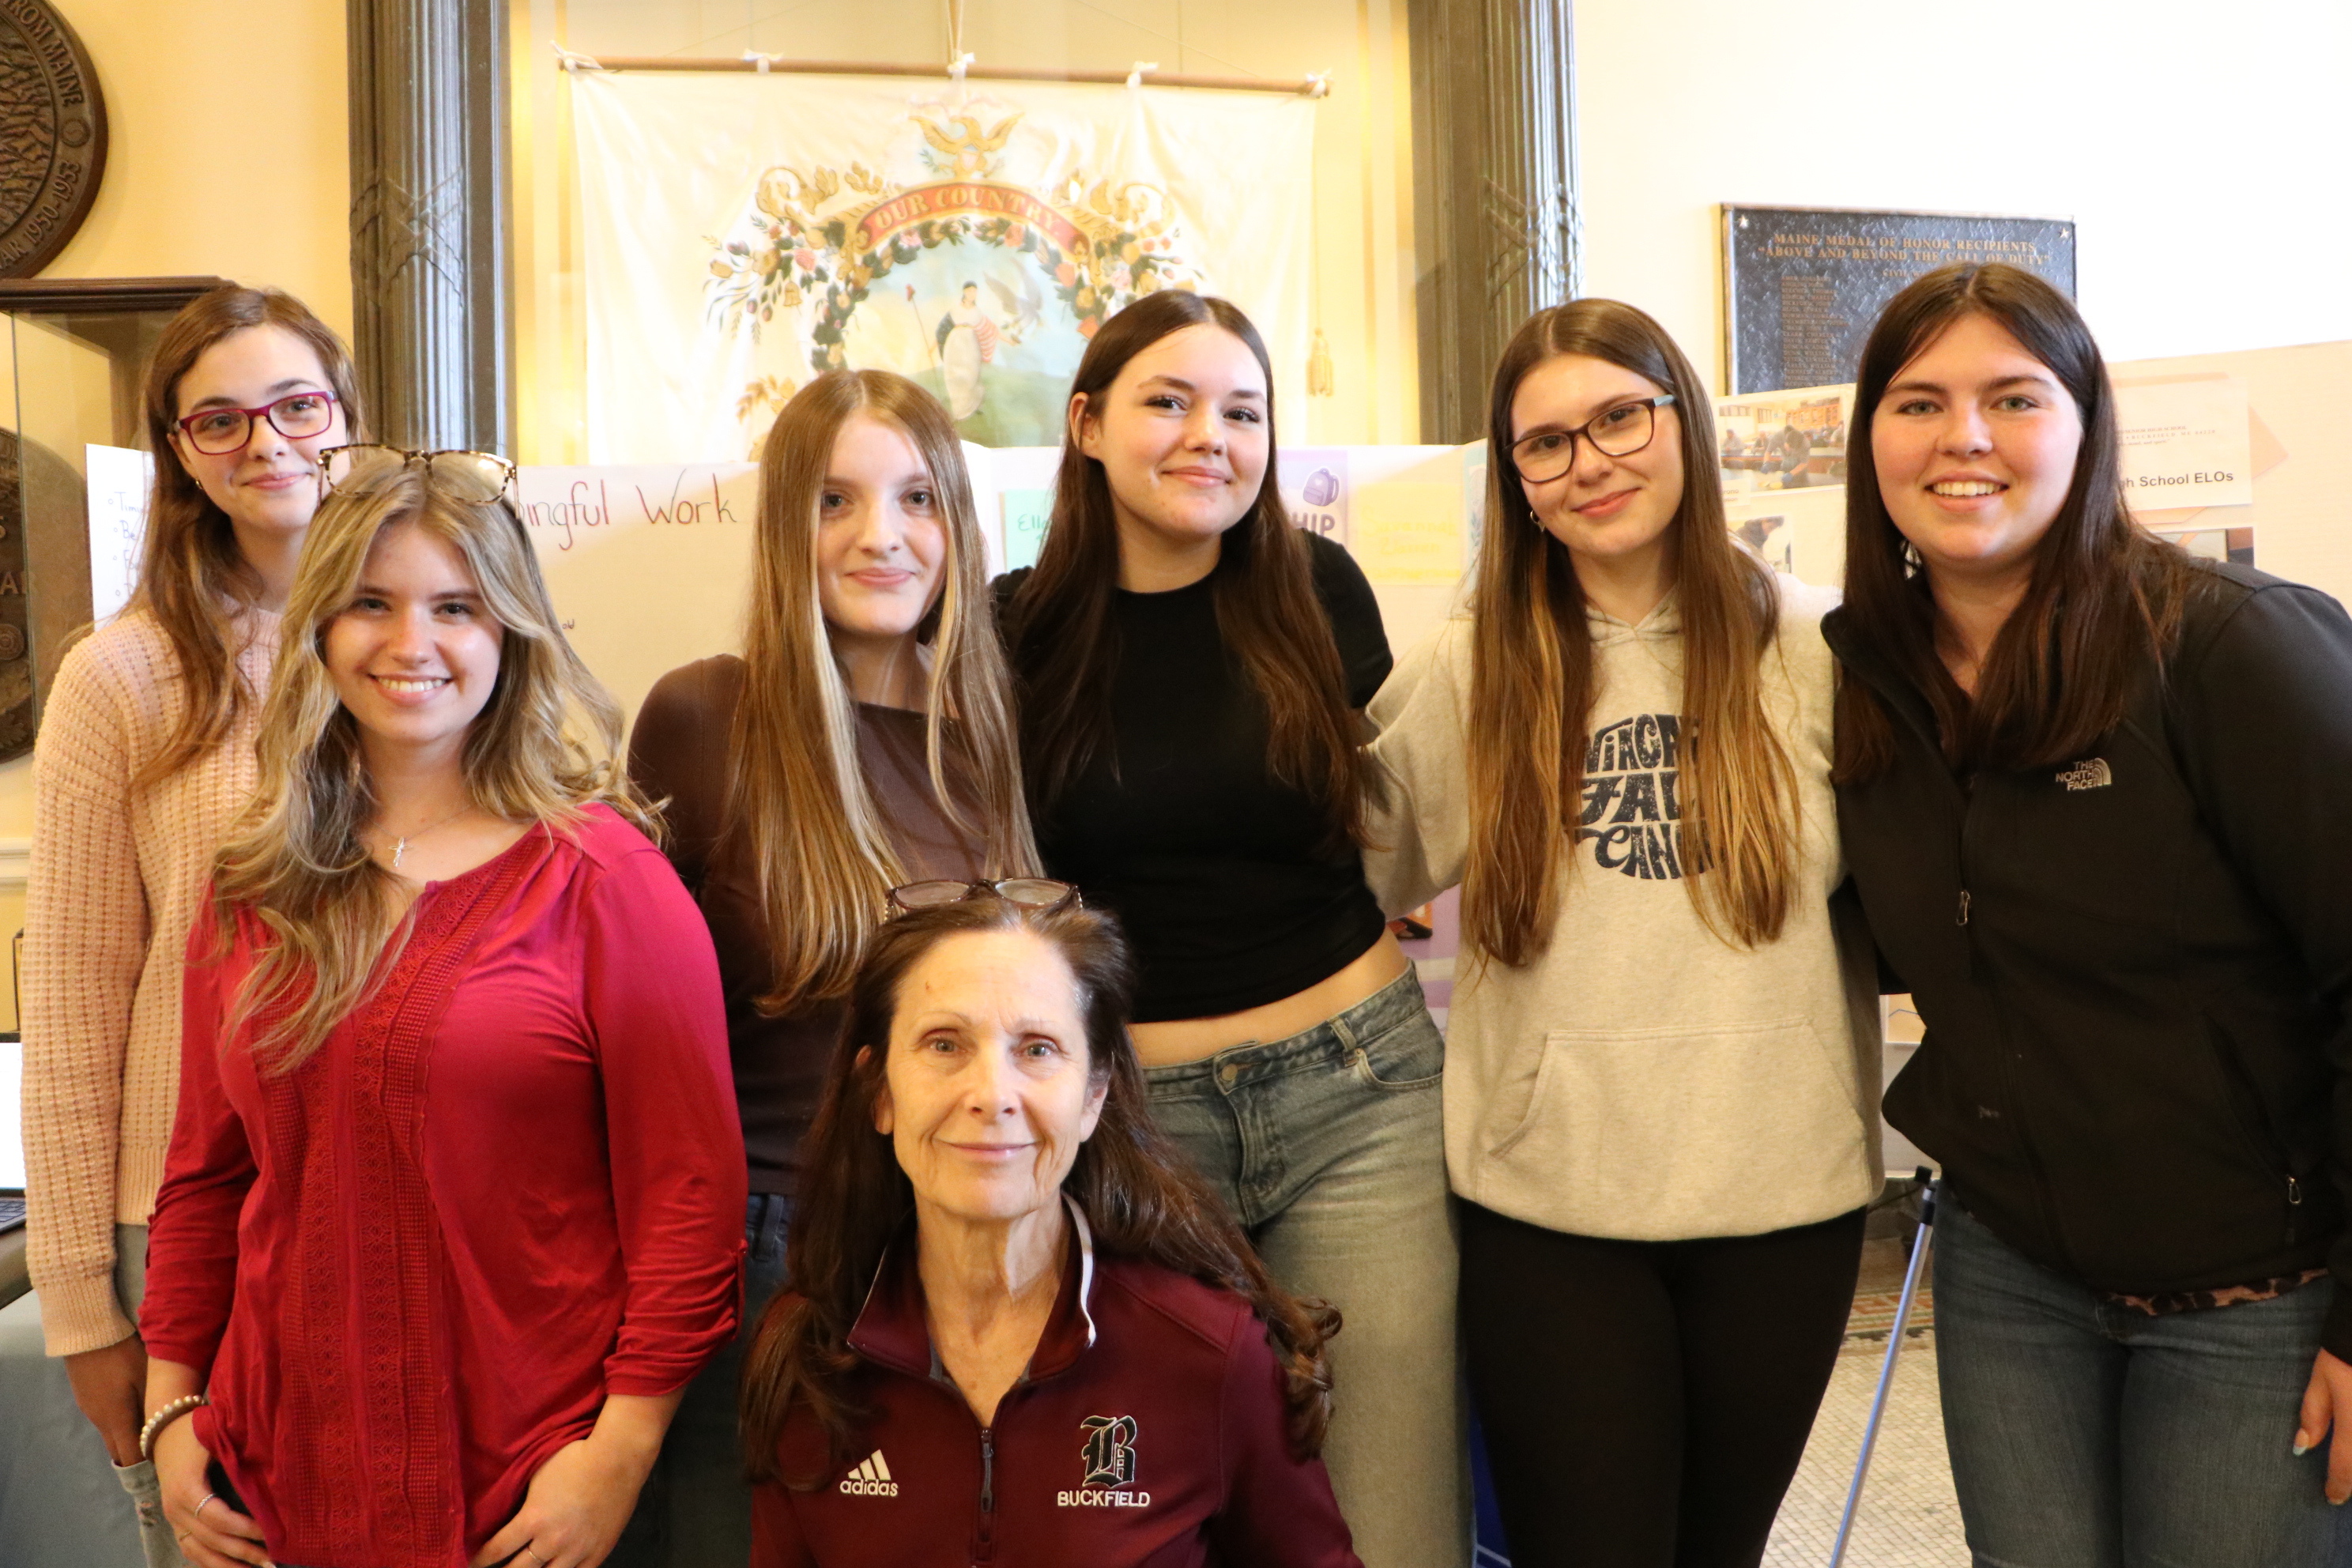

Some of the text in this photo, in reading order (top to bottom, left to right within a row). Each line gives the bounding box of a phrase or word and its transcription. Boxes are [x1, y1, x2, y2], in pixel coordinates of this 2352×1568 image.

[4, 0, 85, 107] ROM MAINE
[0, 160, 81, 269] AR 1950-1953
[874, 192, 931, 230] OUR
[1773, 234, 2036, 252] MAINE MEDAL OF HONOR RECIPIENTS
[1818, 247, 1846, 258] AND
[1852, 249, 1908, 260] BEYOND
[1914, 251, 1939, 262] THE
[1985, 254, 2003, 262] OF
[2139, 473, 2189, 487] School
[2194, 471, 2234, 484] ELOs
[635, 468, 737, 524] Work
[1291, 511, 1336, 537] HIP
[2073, 760, 2094, 771] THE
[2056, 769, 2094, 782] NORTH
[2067, 778, 2094, 791] FACE
[839, 1478, 899, 1497] adidas
[1057, 1490, 1151, 1507] BUCKFIELD
